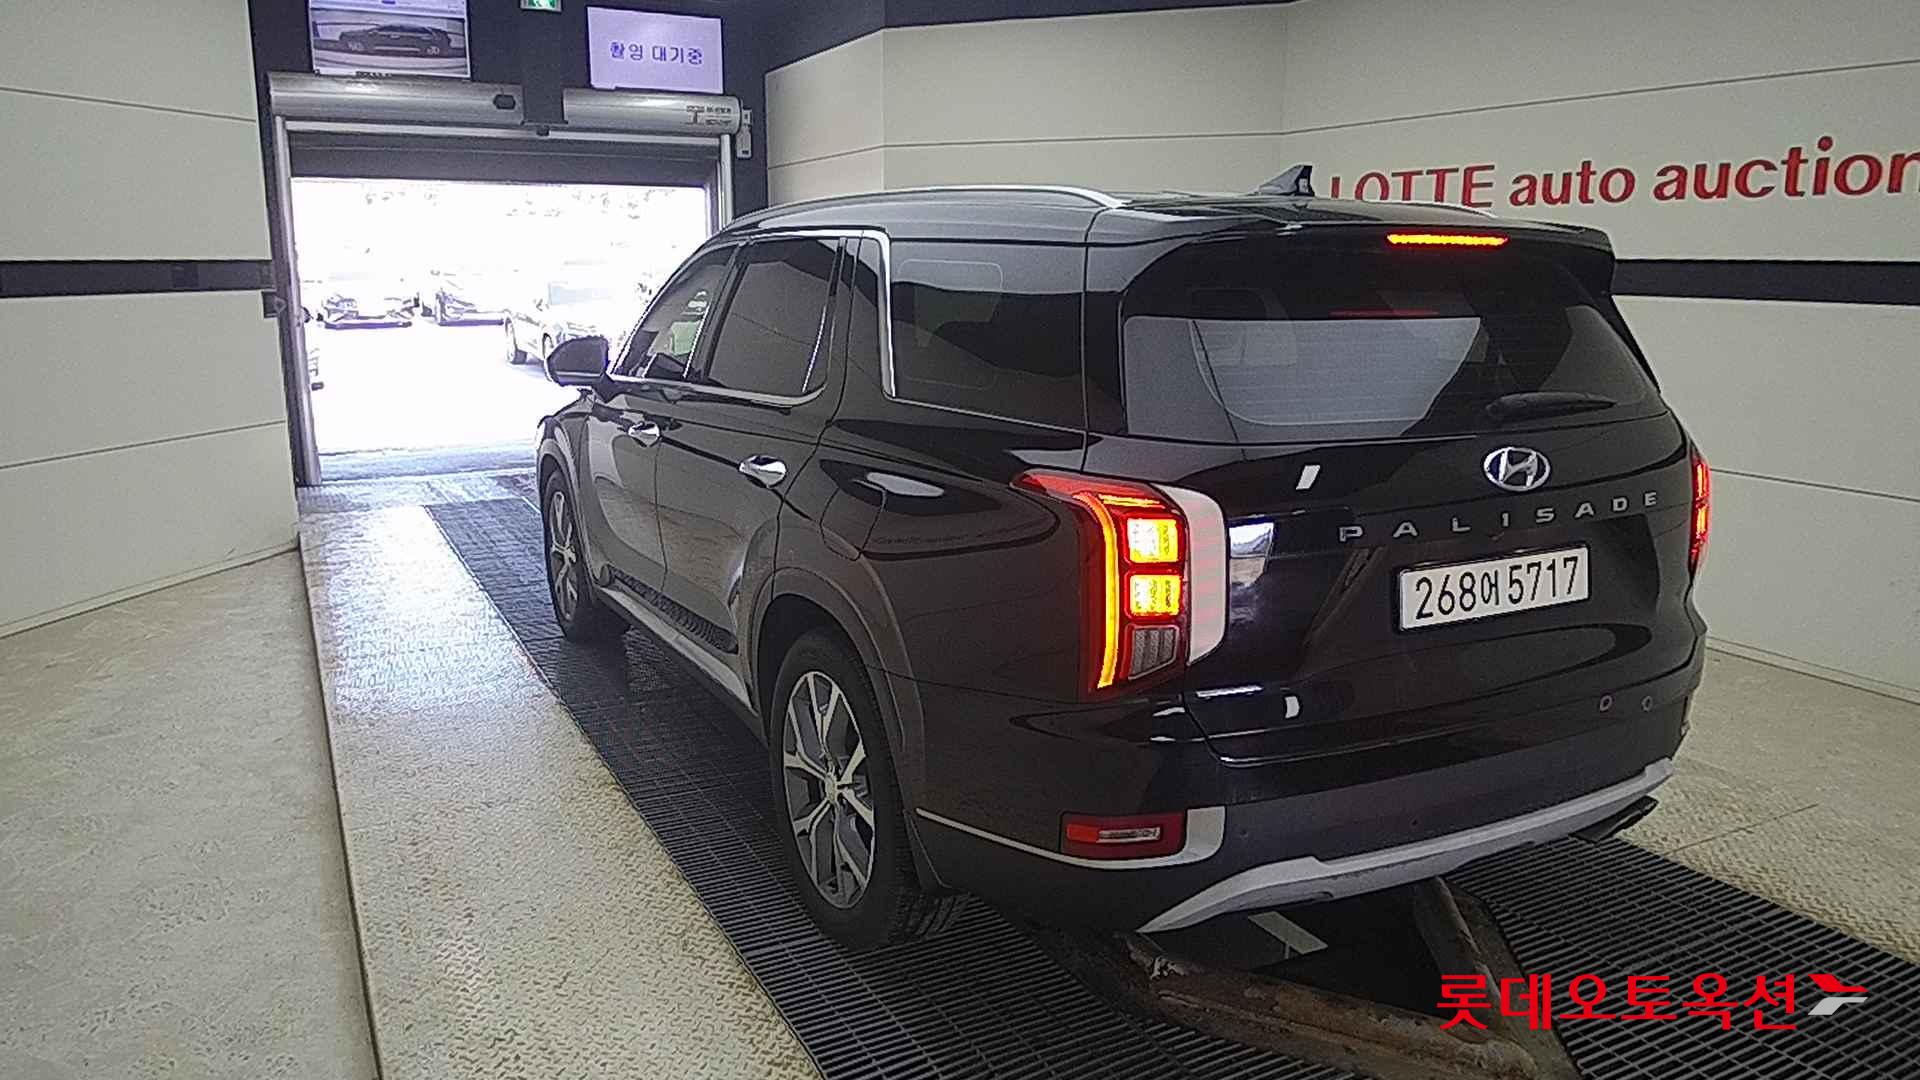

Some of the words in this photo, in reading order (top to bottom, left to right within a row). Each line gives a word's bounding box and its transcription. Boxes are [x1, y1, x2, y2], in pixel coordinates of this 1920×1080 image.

[652, 44, 702, 65] 대기중
[1509, 159, 1636, 206] auto
[1652, 135, 1920, 201] auction
[1339, 491, 1658, 542] PALISADE
[1415, 555, 1579, 620] 268어5717
